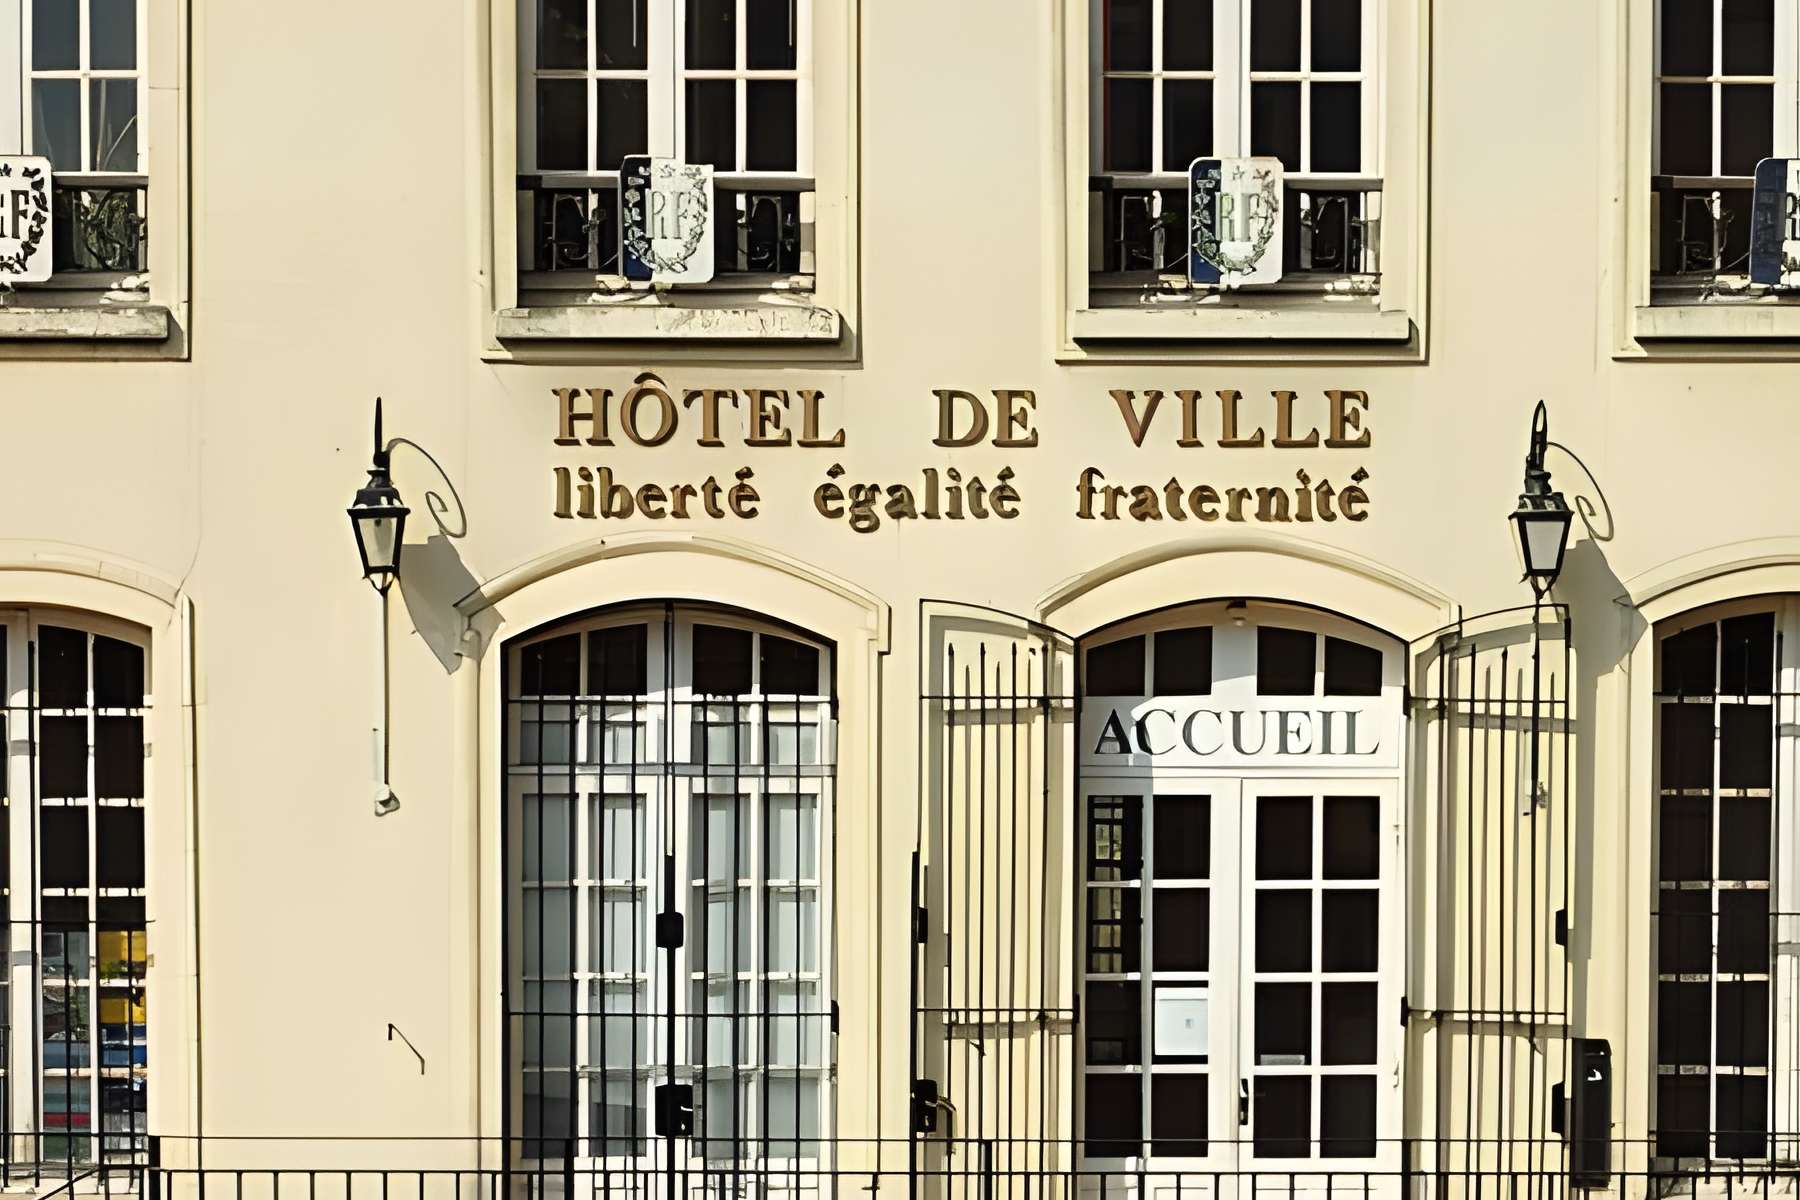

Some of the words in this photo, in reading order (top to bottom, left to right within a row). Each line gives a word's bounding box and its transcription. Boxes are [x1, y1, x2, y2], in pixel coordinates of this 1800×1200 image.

[645, 188, 691, 239] RF
[1214, 191, 1260, 241] RF
[552, 372, 846, 447] HÔTEL
[931, 389, 1039, 448] DE
[1109, 389, 1372, 448] VILLE
[553, 465, 761, 519] liberté
[813, 462, 1021, 533] égalité
[1075, 467, 1370, 523] fraternité
[1094, 708, 1380, 756] ACCUEIL
